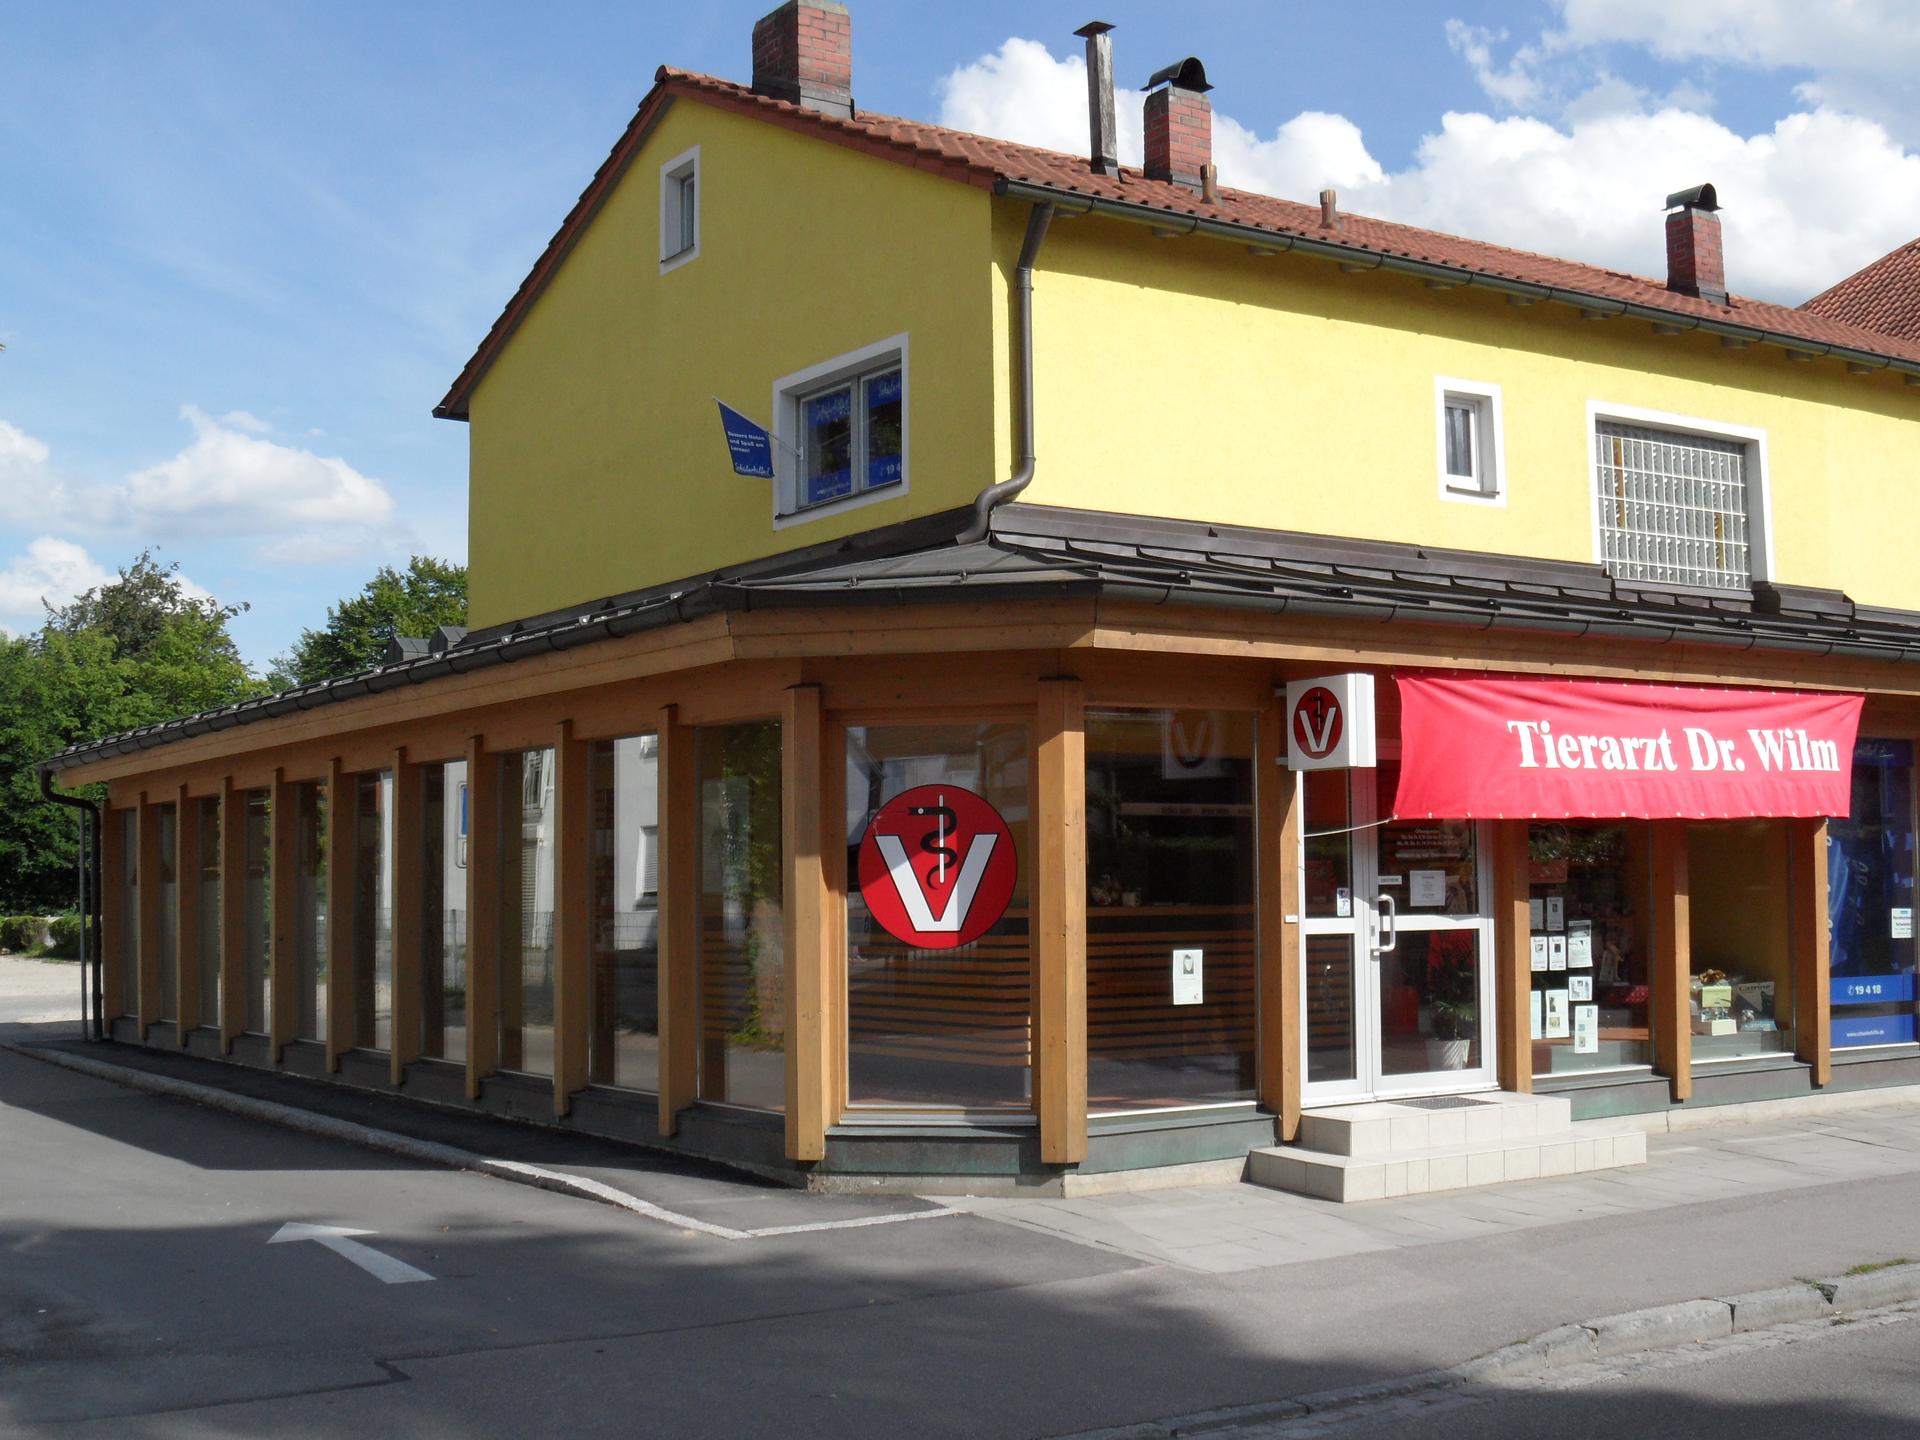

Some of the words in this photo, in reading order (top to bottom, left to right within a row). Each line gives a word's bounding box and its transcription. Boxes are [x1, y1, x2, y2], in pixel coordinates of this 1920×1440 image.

[1506, 719, 1679, 772] Tierarzt
[1682, 727, 1746, 772] Dr.
[1747, 728, 1841, 772] Wilm
[1855, 985, 1865, 996] 19
[1865, 985, 1872, 995] 4
[1872, 984, 1882, 995] 18
